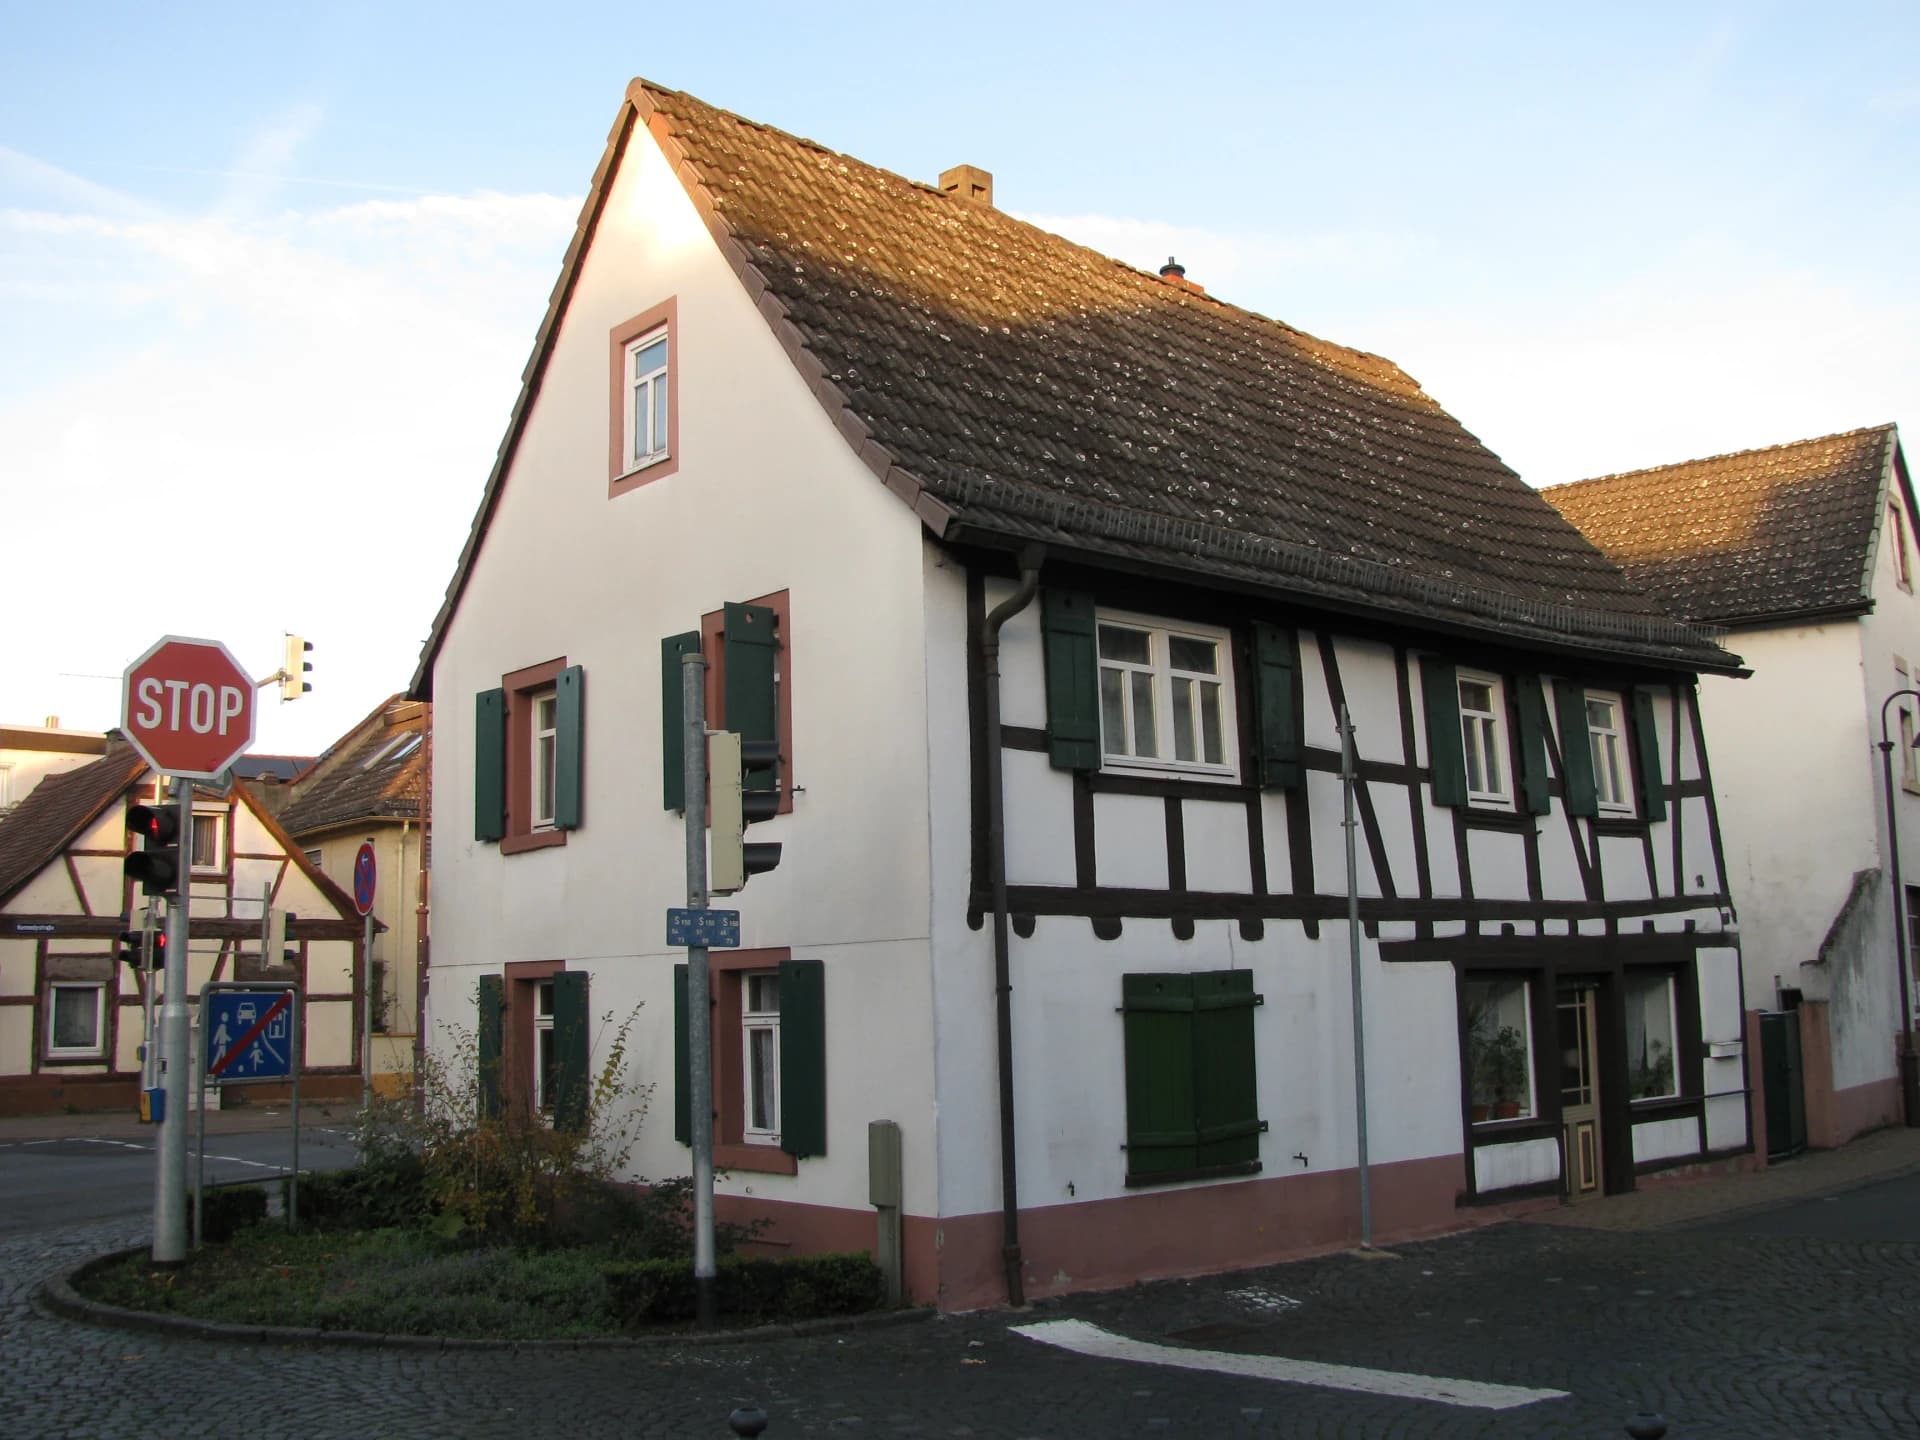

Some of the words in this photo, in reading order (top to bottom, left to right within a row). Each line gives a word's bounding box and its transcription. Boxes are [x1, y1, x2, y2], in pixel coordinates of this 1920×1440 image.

[136, 677, 244, 736] STOP
[674, 915, 681, 926] S
[698, 916, 705, 927] S
[722, 917, 729, 928] S
